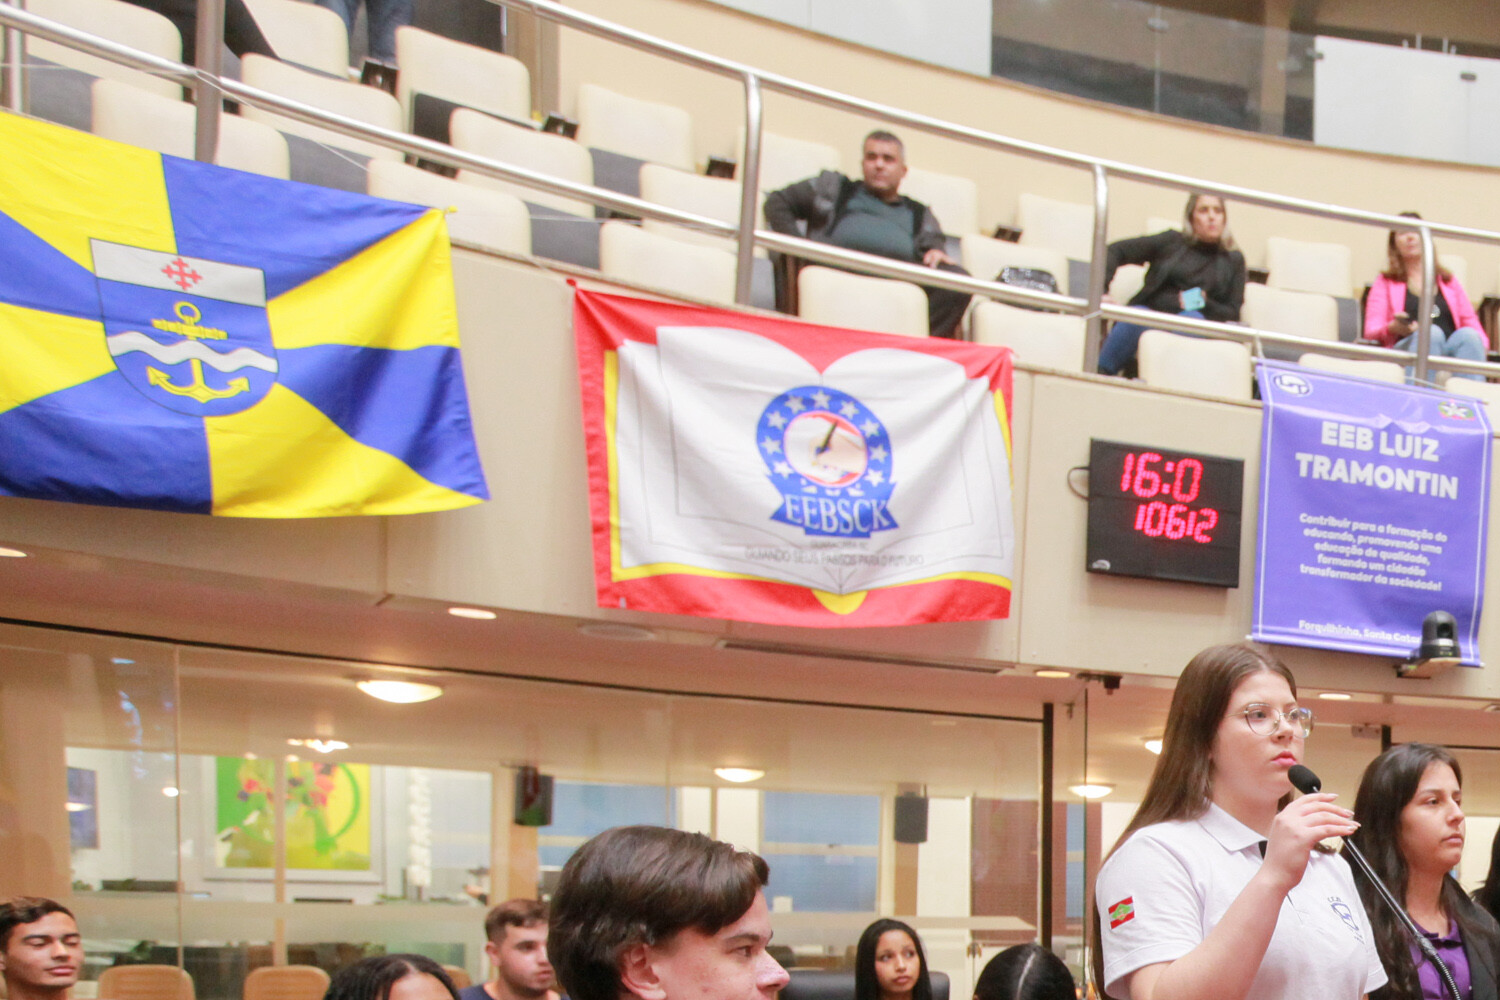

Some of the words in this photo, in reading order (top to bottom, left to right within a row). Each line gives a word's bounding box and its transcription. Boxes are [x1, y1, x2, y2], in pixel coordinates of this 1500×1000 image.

[1321, 420, 1374, 451] EEB
[1379, 431, 1439, 462] LUIZ
[1295, 452, 1459, 500] TRAMONTIN
[784, 494, 891, 534] EEBSCK
[1299, 513, 1351, 529] Contribuir
[1352, 521, 1376, 532] para
[1386, 524, 1433, 540] formação
[1435, 532, 1448, 542] do
[1303, 528, 1356, 543] educando,
[1357, 534, 1419, 551] promovendo
[1420, 544, 1442, 554] uma
[1314, 542, 1364, 557] educação
[1379, 551, 1431, 566] qualidade,
[1300, 564, 1373, 582] transformador
[1389, 576, 1442, 591] sociedade!
[1318, 553, 1367, 569] formando
[1369, 562, 1385, 571] um
[1386, 564, 1426, 577] cidadão
[1364, 628, 1393, 641] Santa
[1393, 632, 1422, 644] Catar
